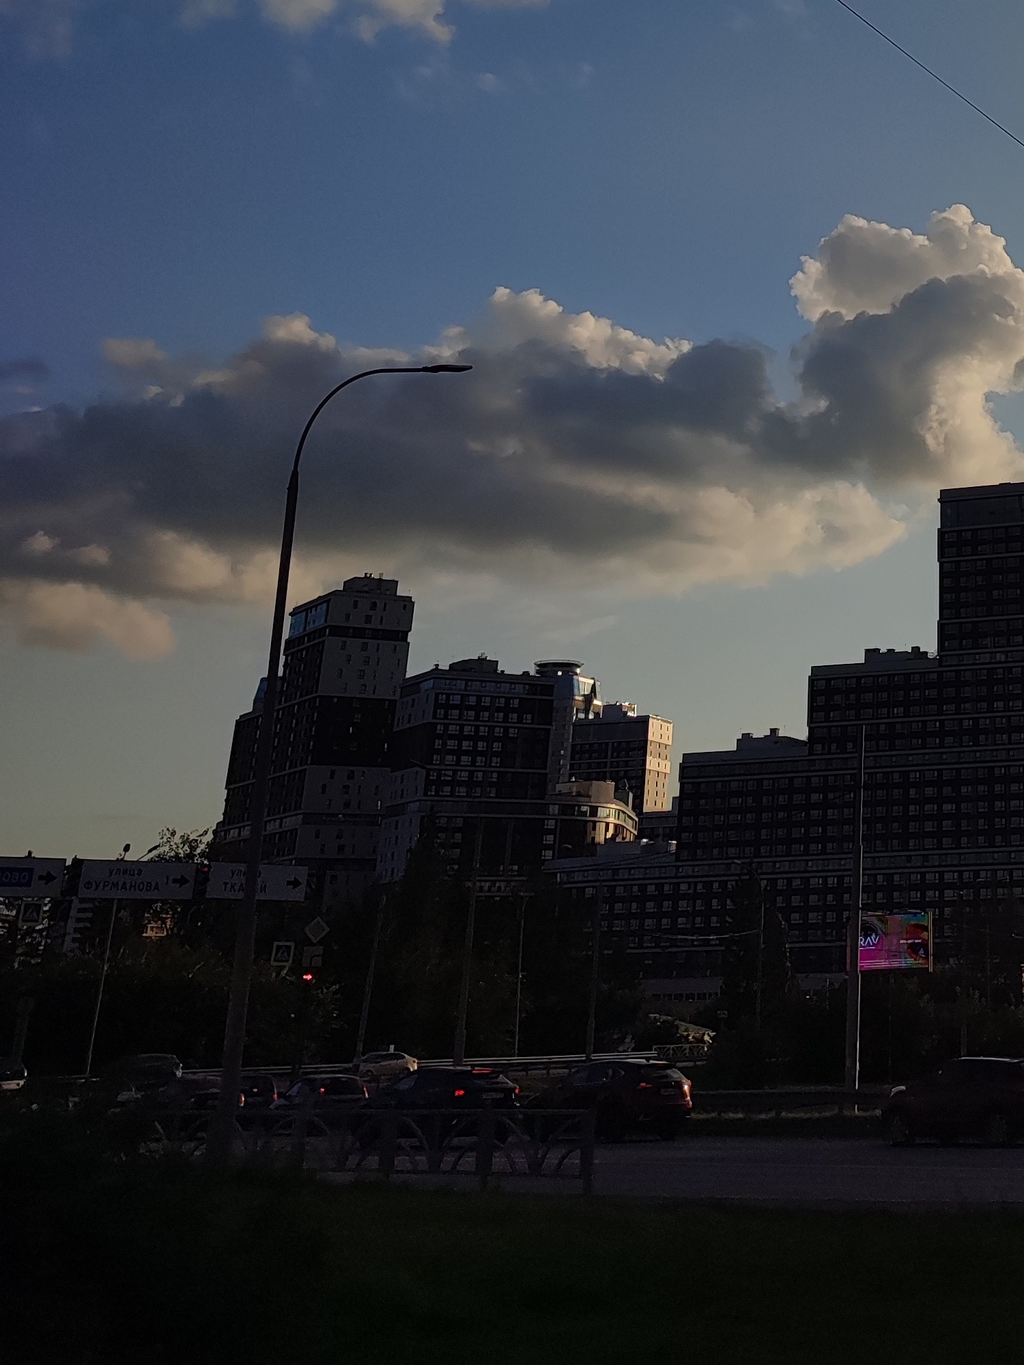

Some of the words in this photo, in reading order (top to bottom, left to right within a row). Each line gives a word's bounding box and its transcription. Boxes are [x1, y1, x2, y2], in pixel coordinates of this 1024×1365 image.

[0, 871, 28, 883] ОВО
[108, 868, 143, 877] улица
[230, 868, 261, 878] улиа
[83, 880, 160, 892] ФУРМАНОВА
[222, 880, 267, 894] ТКАЙ
